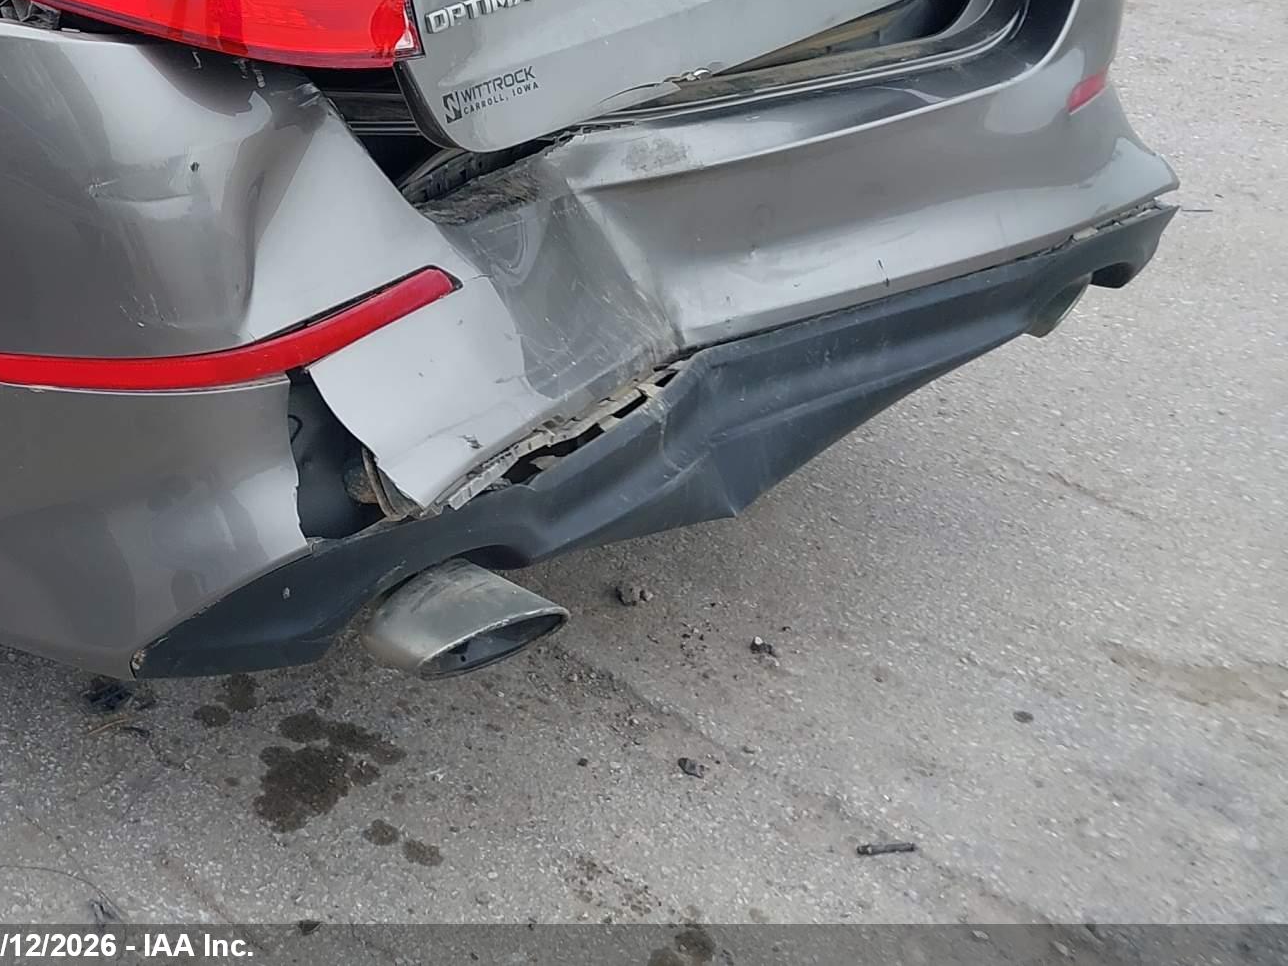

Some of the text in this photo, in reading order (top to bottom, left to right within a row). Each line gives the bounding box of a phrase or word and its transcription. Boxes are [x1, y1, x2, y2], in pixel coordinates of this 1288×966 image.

[460, 65, 536, 103] WITTROCK
[463, 81, 539, 115] CARROLL, IOWA
